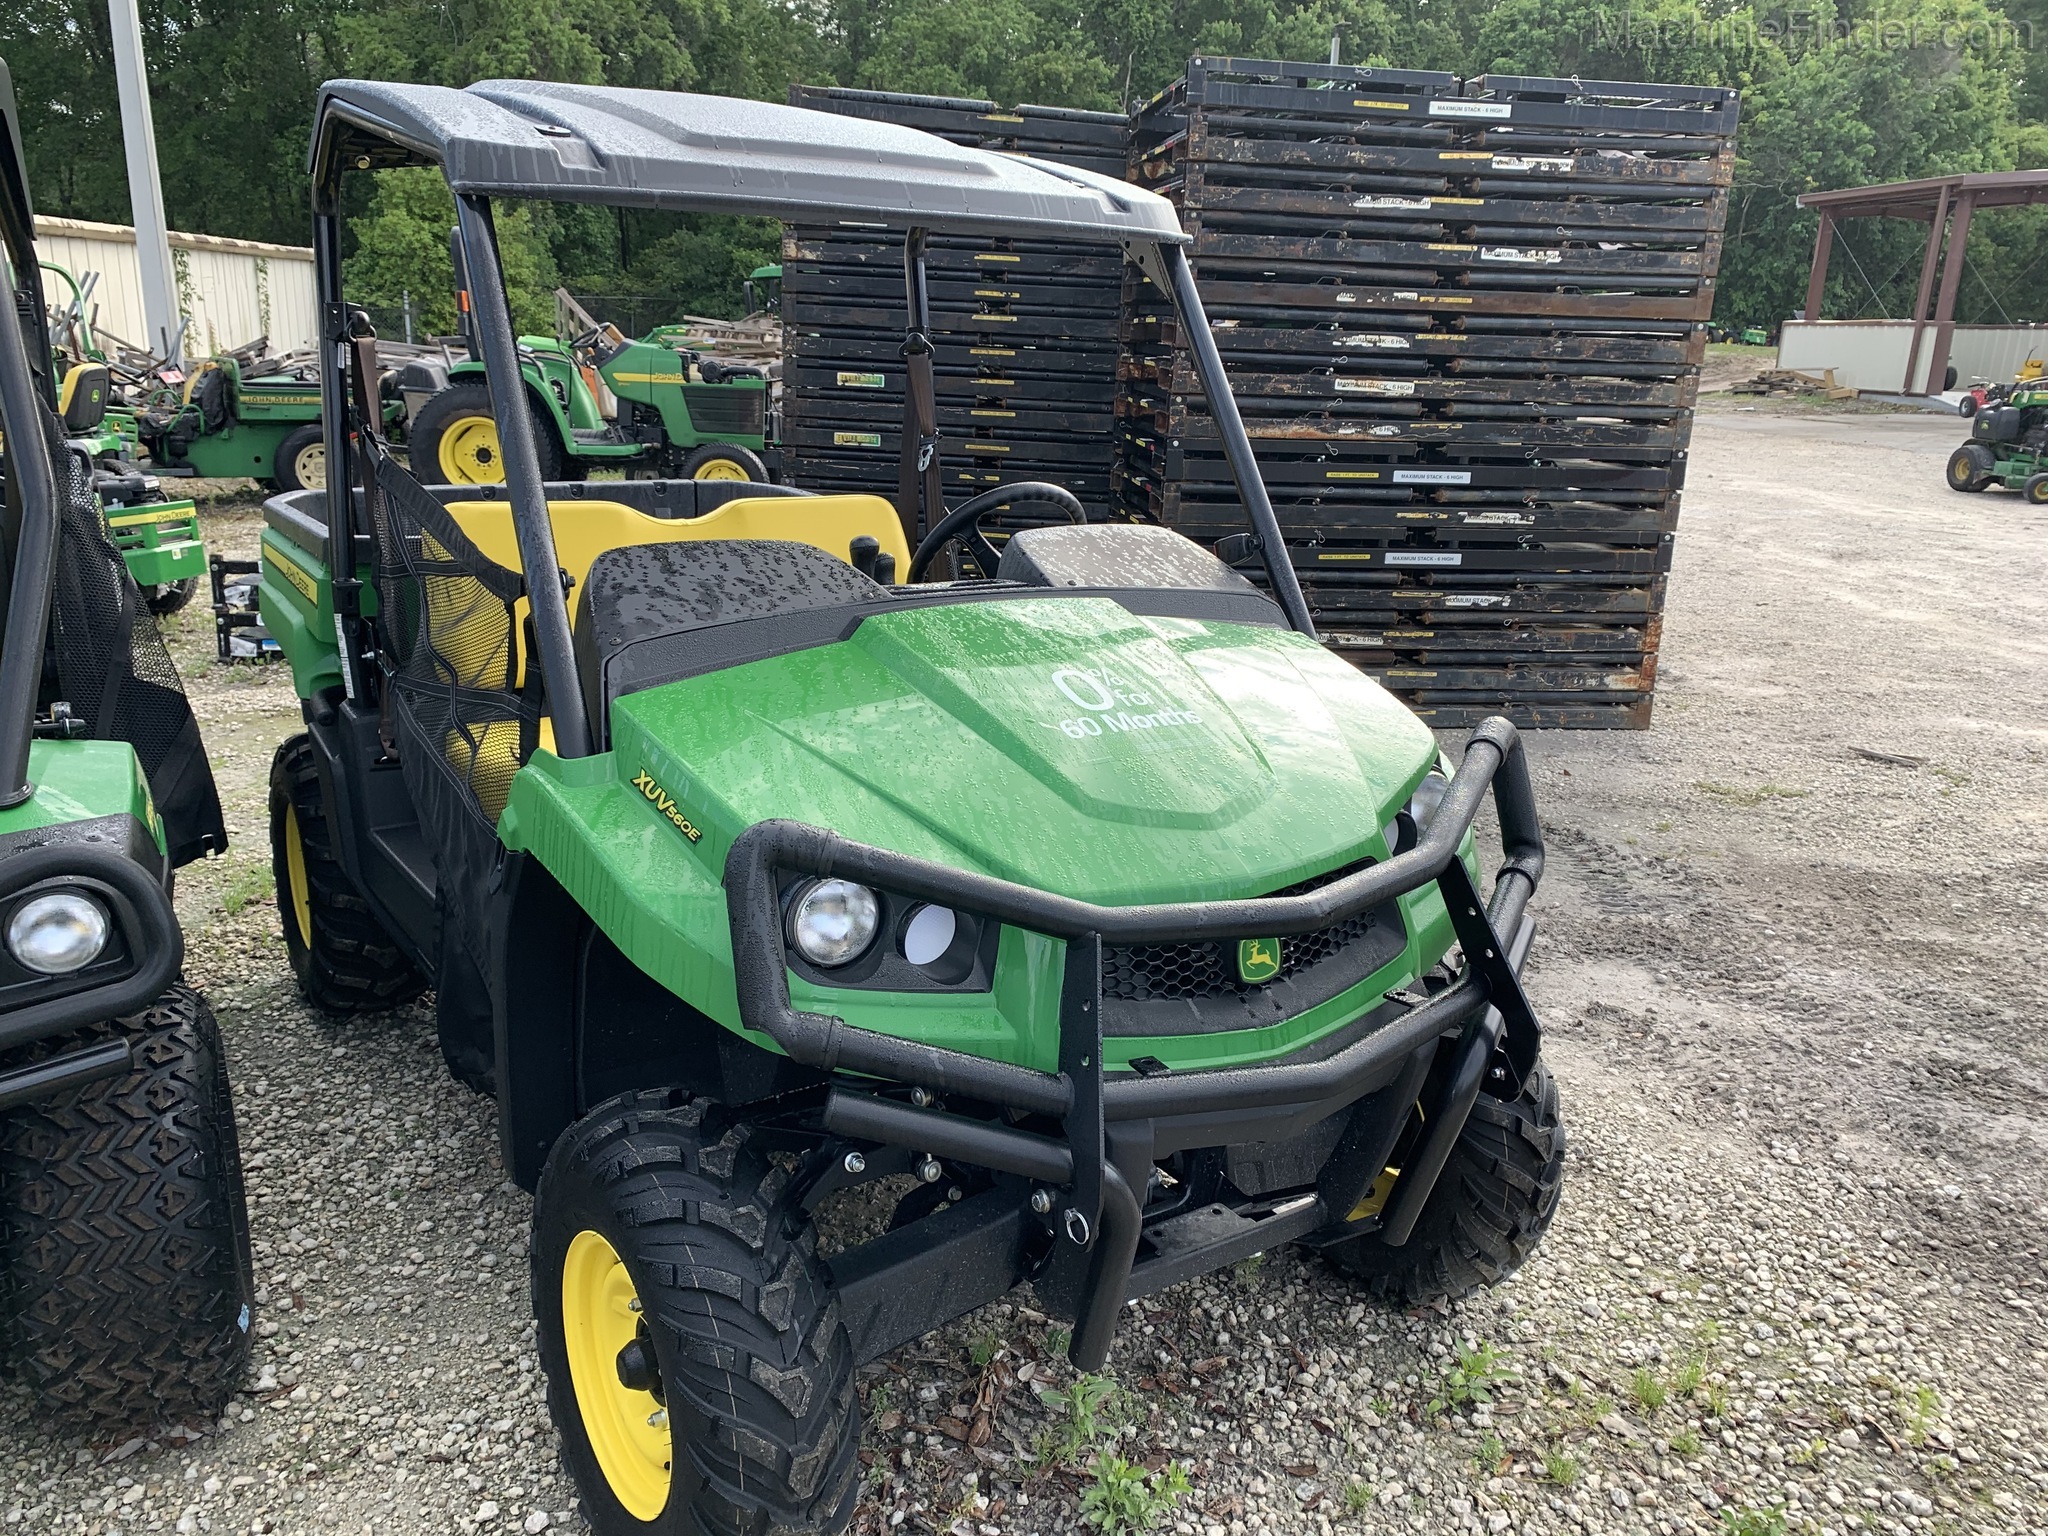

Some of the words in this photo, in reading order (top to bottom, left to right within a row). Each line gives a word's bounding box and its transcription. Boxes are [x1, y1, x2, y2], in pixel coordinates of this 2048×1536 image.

[155, 512, 171, 522] JOHN
[172, 510, 190, 520] DEERE
[1060, 717, 1103, 739] 60
[1101, 706, 1203, 733] Months
[631, 767, 702, 844] XUV560E
